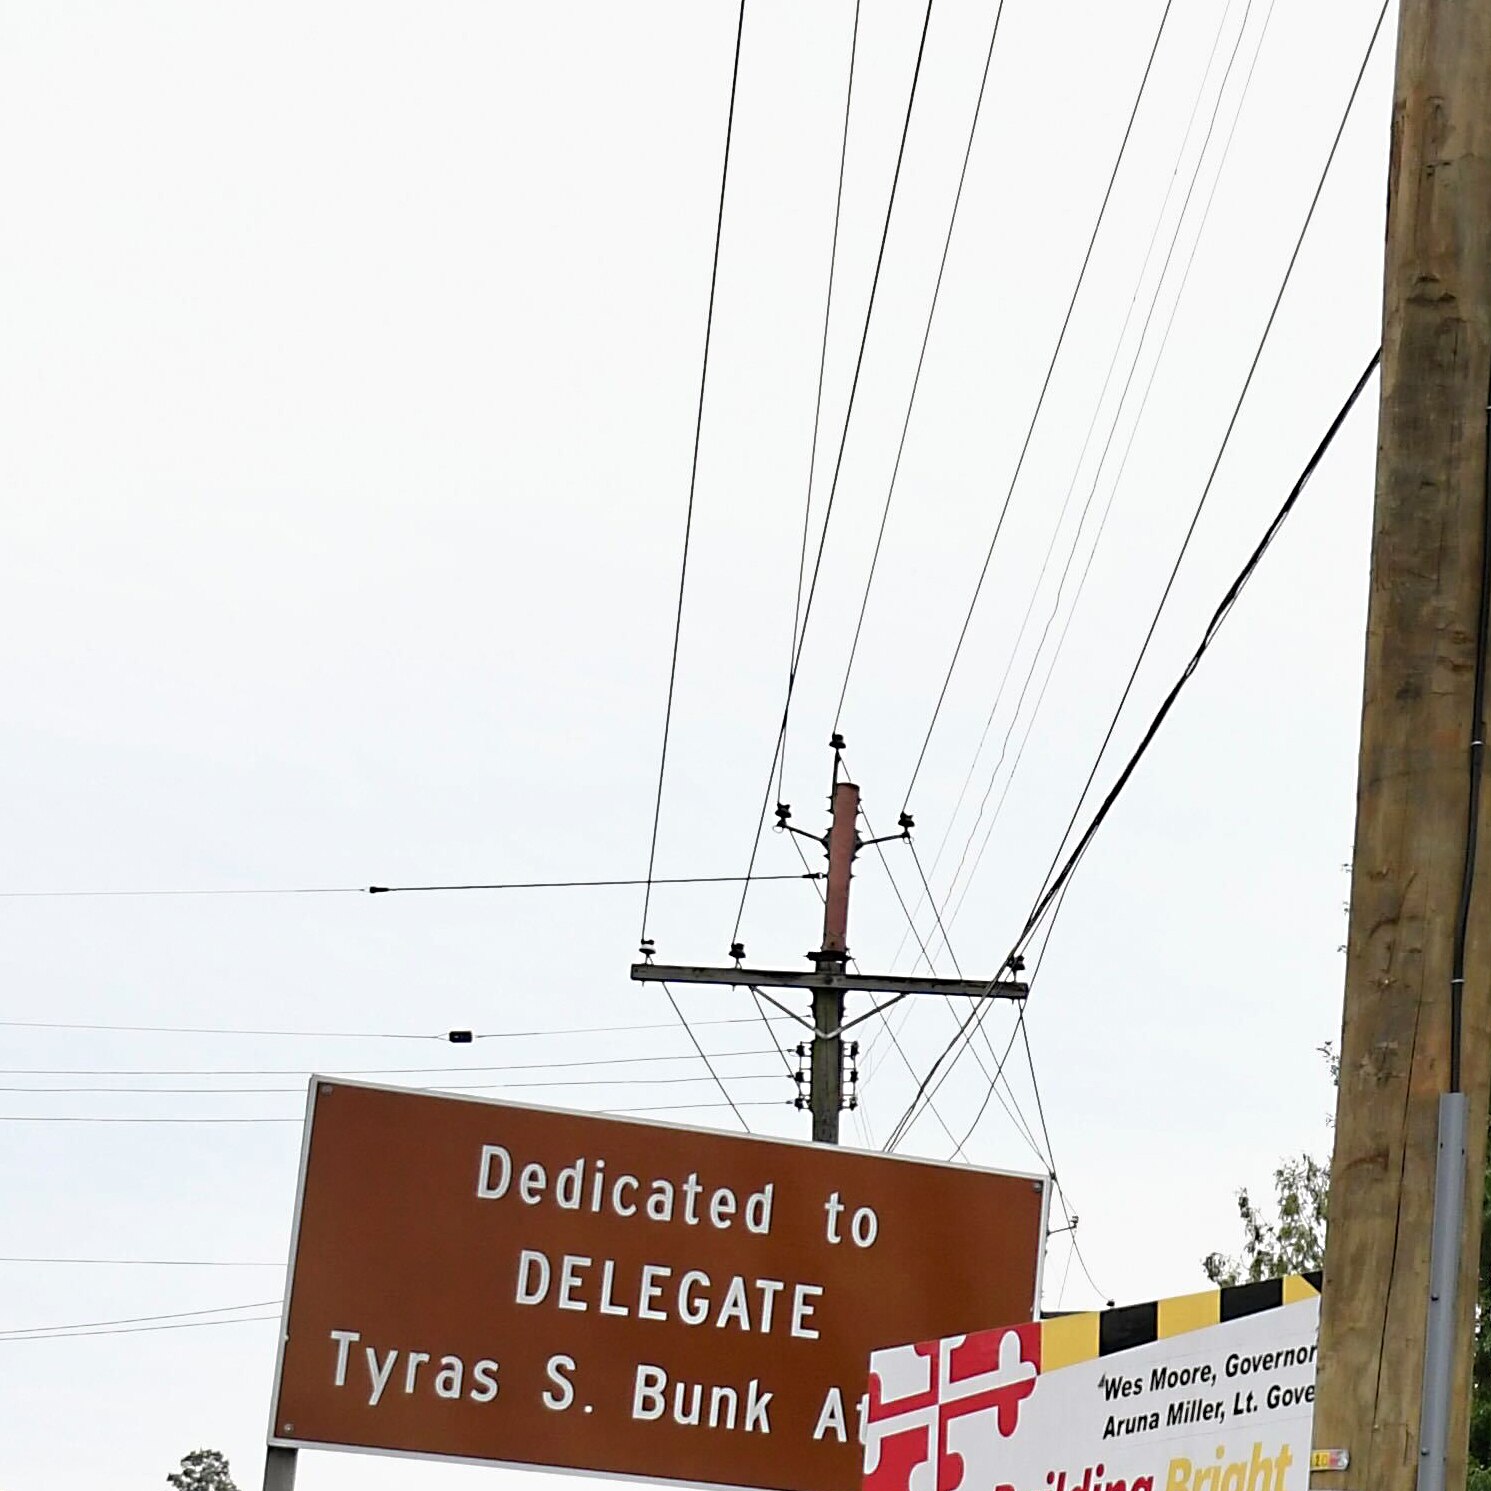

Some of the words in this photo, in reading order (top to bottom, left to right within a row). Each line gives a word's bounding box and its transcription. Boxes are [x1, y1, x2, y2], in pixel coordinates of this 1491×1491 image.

[476, 1143, 774, 1235] Dedicated
[824, 1191, 879, 1249] to
[516, 1249, 823, 1340] DELEGATE
[329, 1329, 500, 1406] Tyras
[542, 1354, 594, 1414] S.
[632, 1364, 774, 1435] Bunk
[1102, 1411, 1160, 1440] Aruna
[1166, 1398, 1226, 1426] Miller,
[1233, 1390, 1258, 1416] Lt.
[1105, 1376, 1143, 1402] Wes
[1150, 1364, 1217, 1391] Moore,
[1225, 1345, 1317, 1378] Governor
